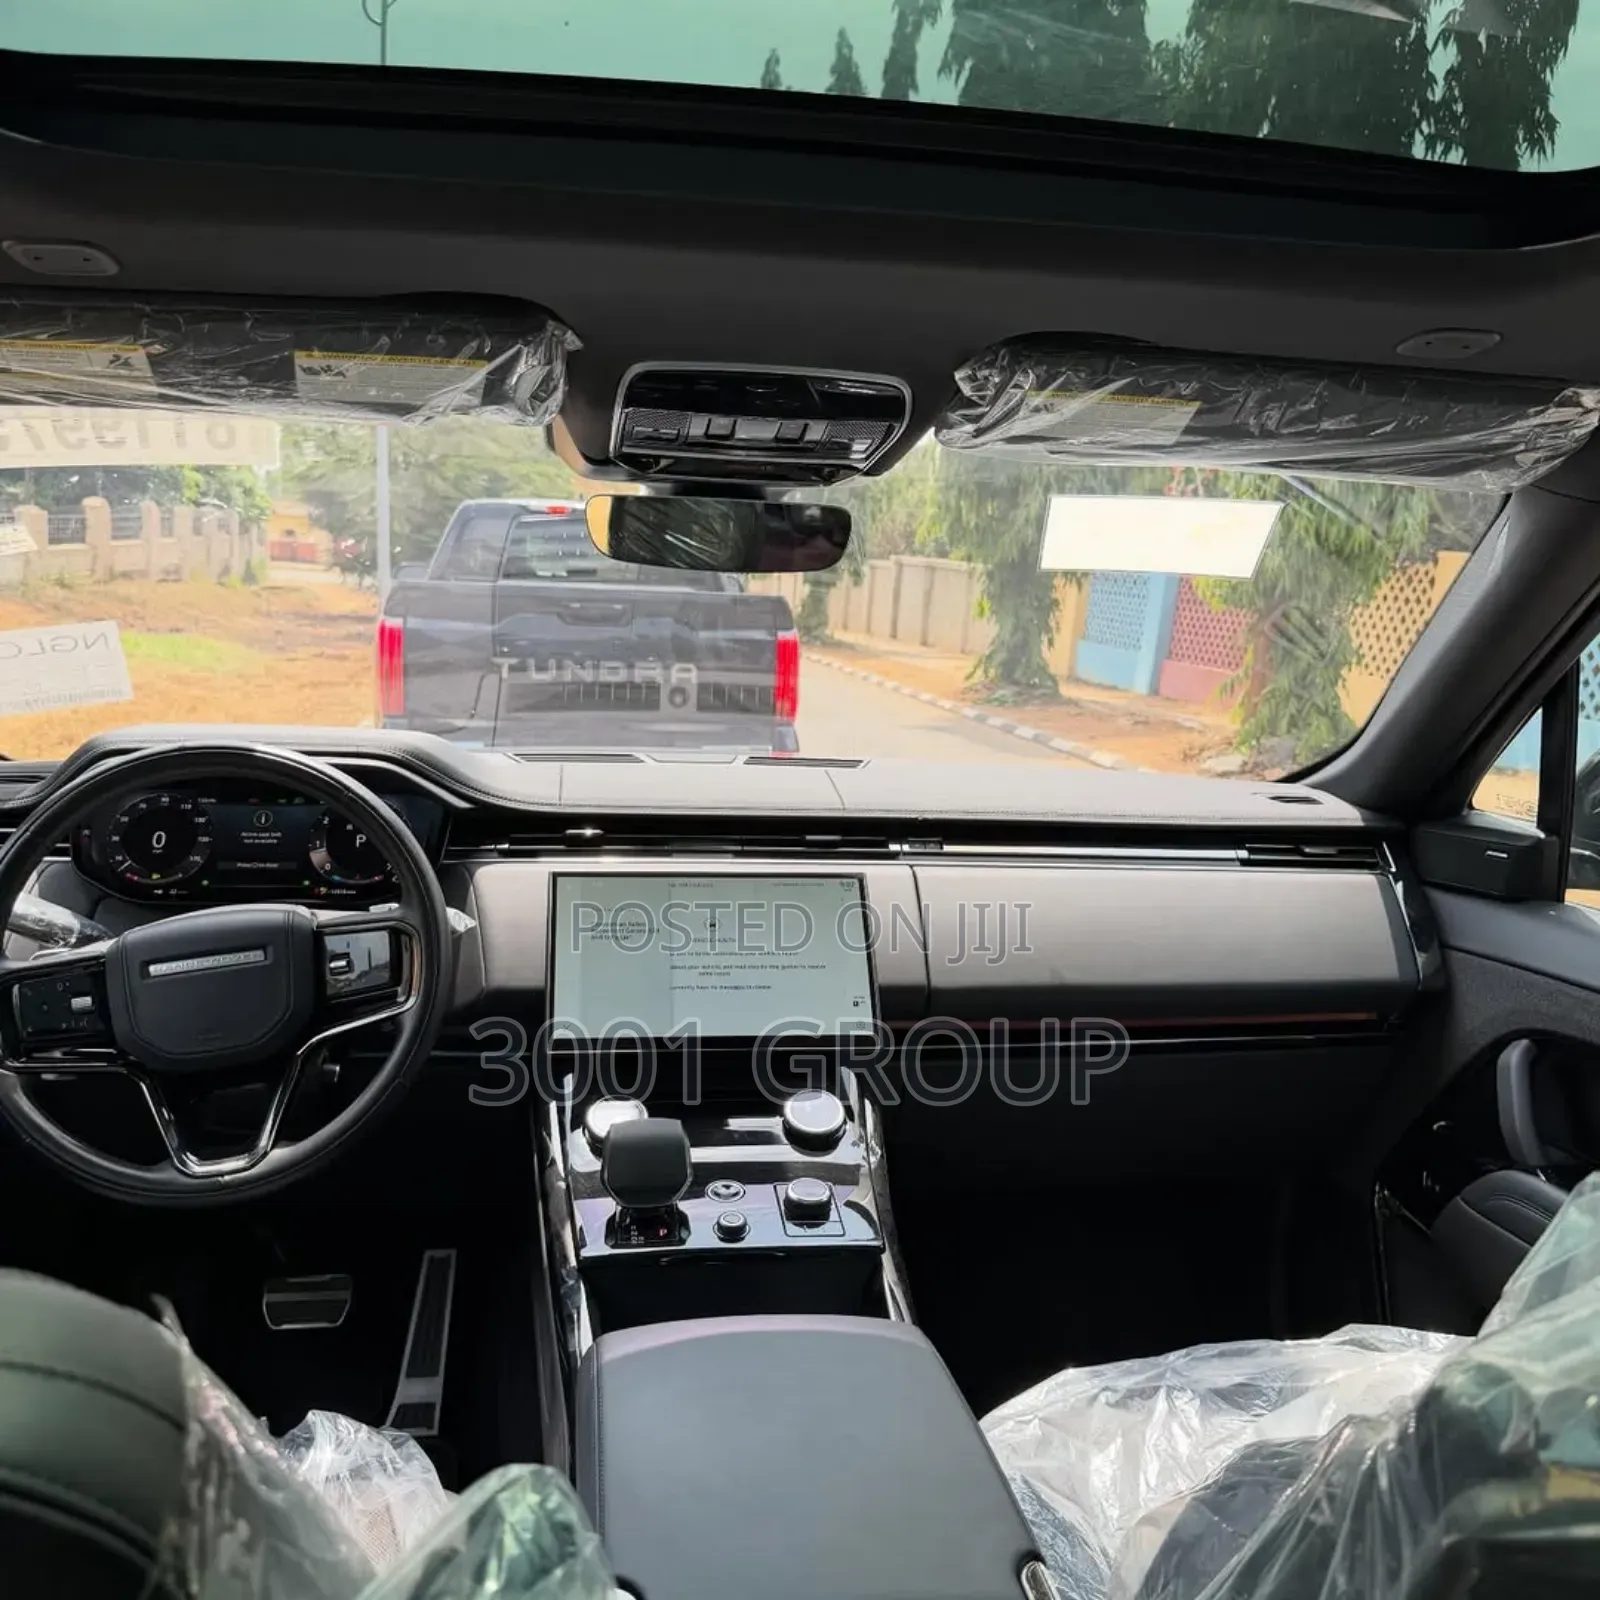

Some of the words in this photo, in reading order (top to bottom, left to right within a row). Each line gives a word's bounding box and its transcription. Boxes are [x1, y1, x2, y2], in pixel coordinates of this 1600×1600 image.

[491, 656, 698, 684] TUNDRA
[152, 831, 166, 848] 0
[356, 835, 366, 848] P
